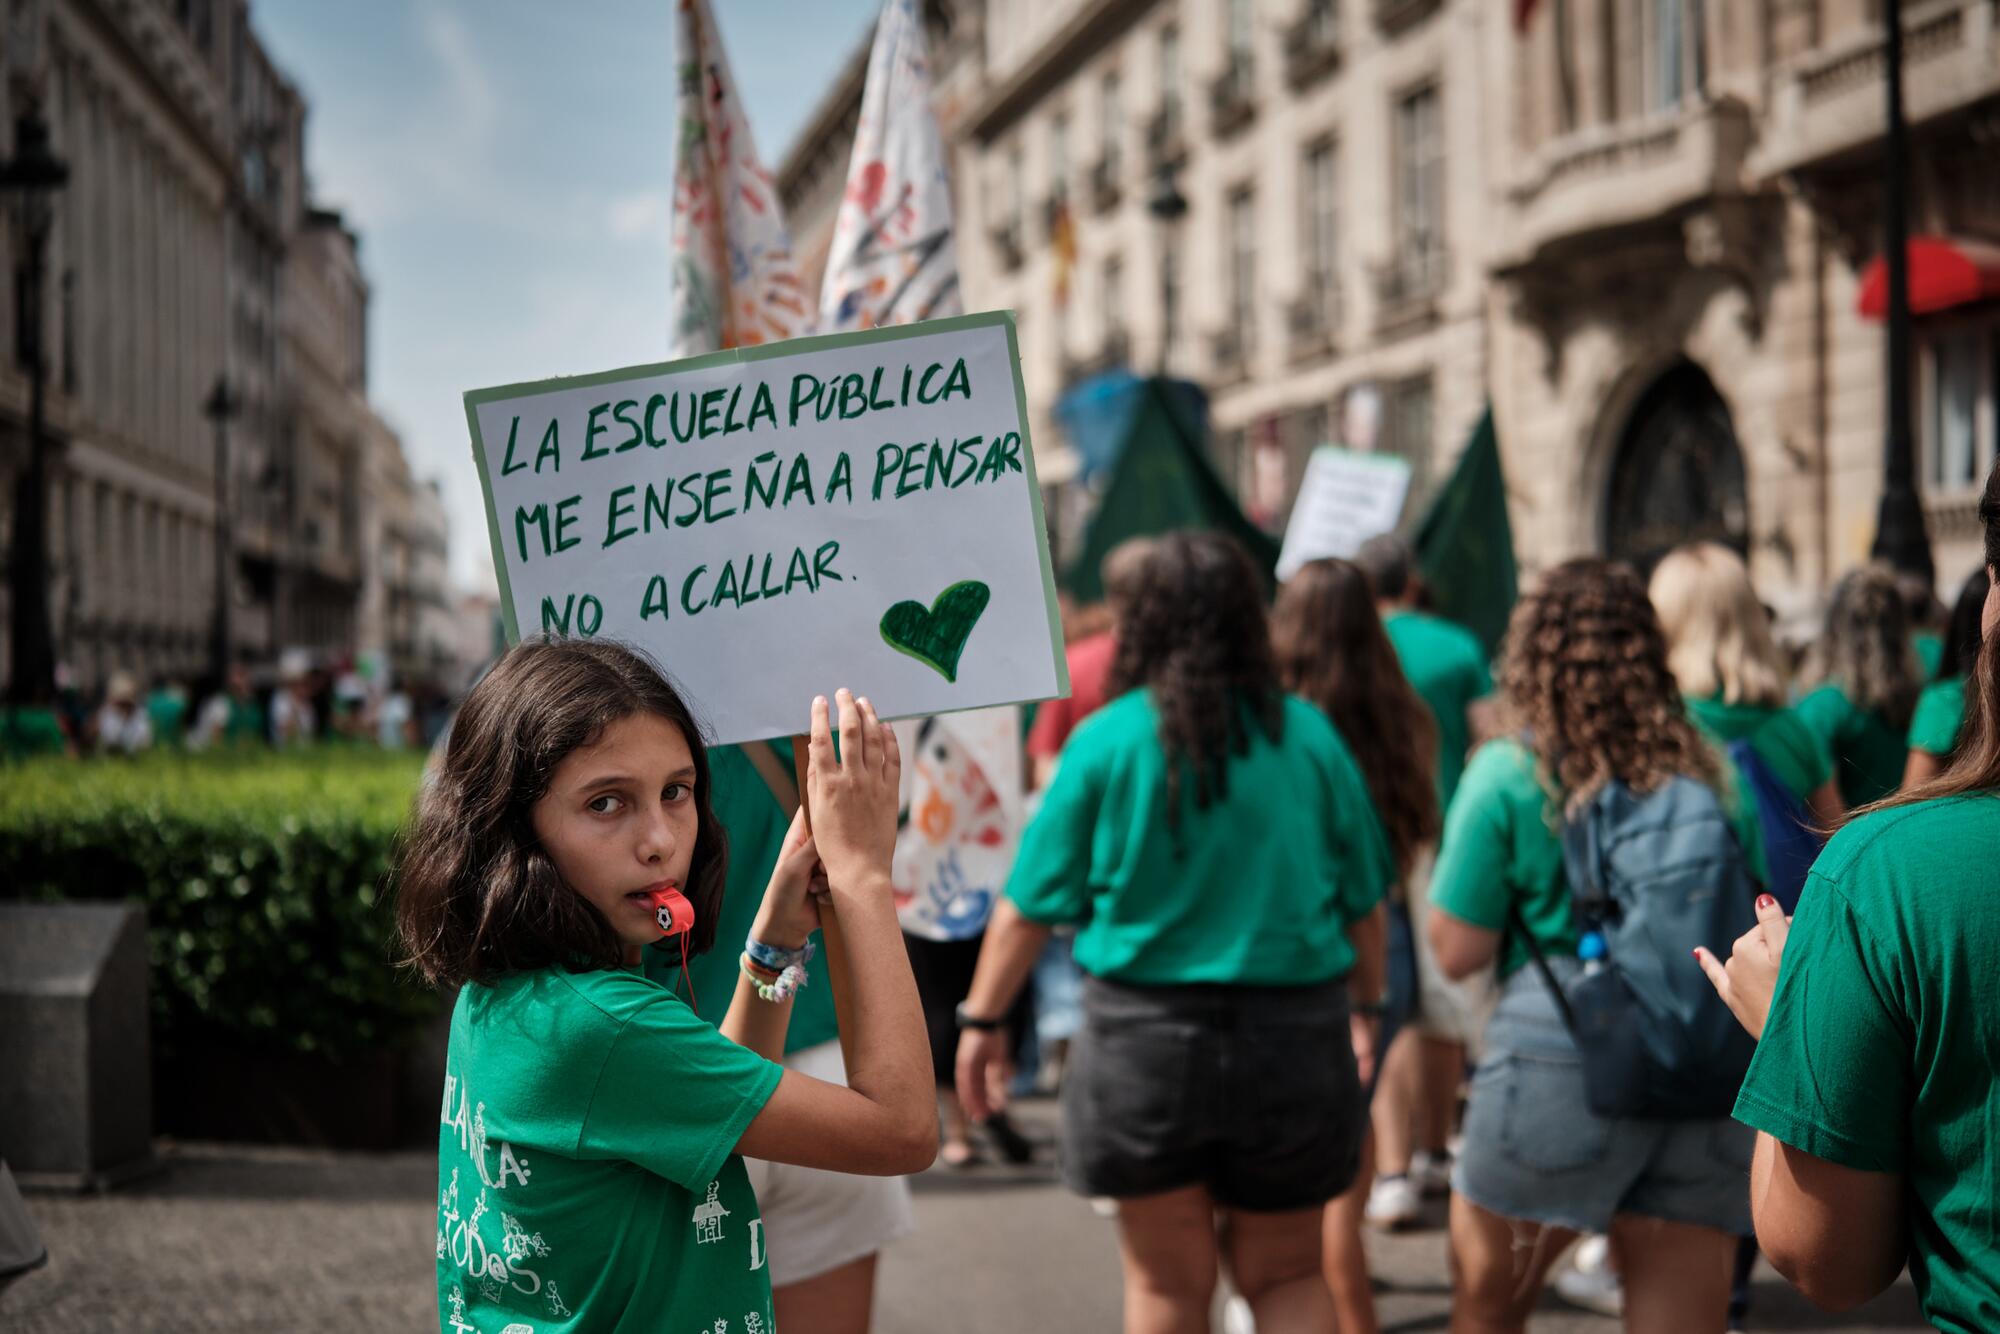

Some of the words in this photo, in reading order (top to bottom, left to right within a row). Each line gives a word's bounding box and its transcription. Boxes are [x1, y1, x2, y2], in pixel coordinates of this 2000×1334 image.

[501, 416, 561, 477] LA
[580, 381, 778, 462] ESCUELA
[788, 357, 972, 427] PÚBLICA
[514, 495, 583, 563] ME
[601, 450, 815, 549] ENSEÑA
[825, 451, 853, 504] A
[871, 431, 1024, 501] PENSAR
[541, 593, 604, 644] NO
[639, 575, 669, 622] A
[680, 540, 858, 617] CALLAR.
